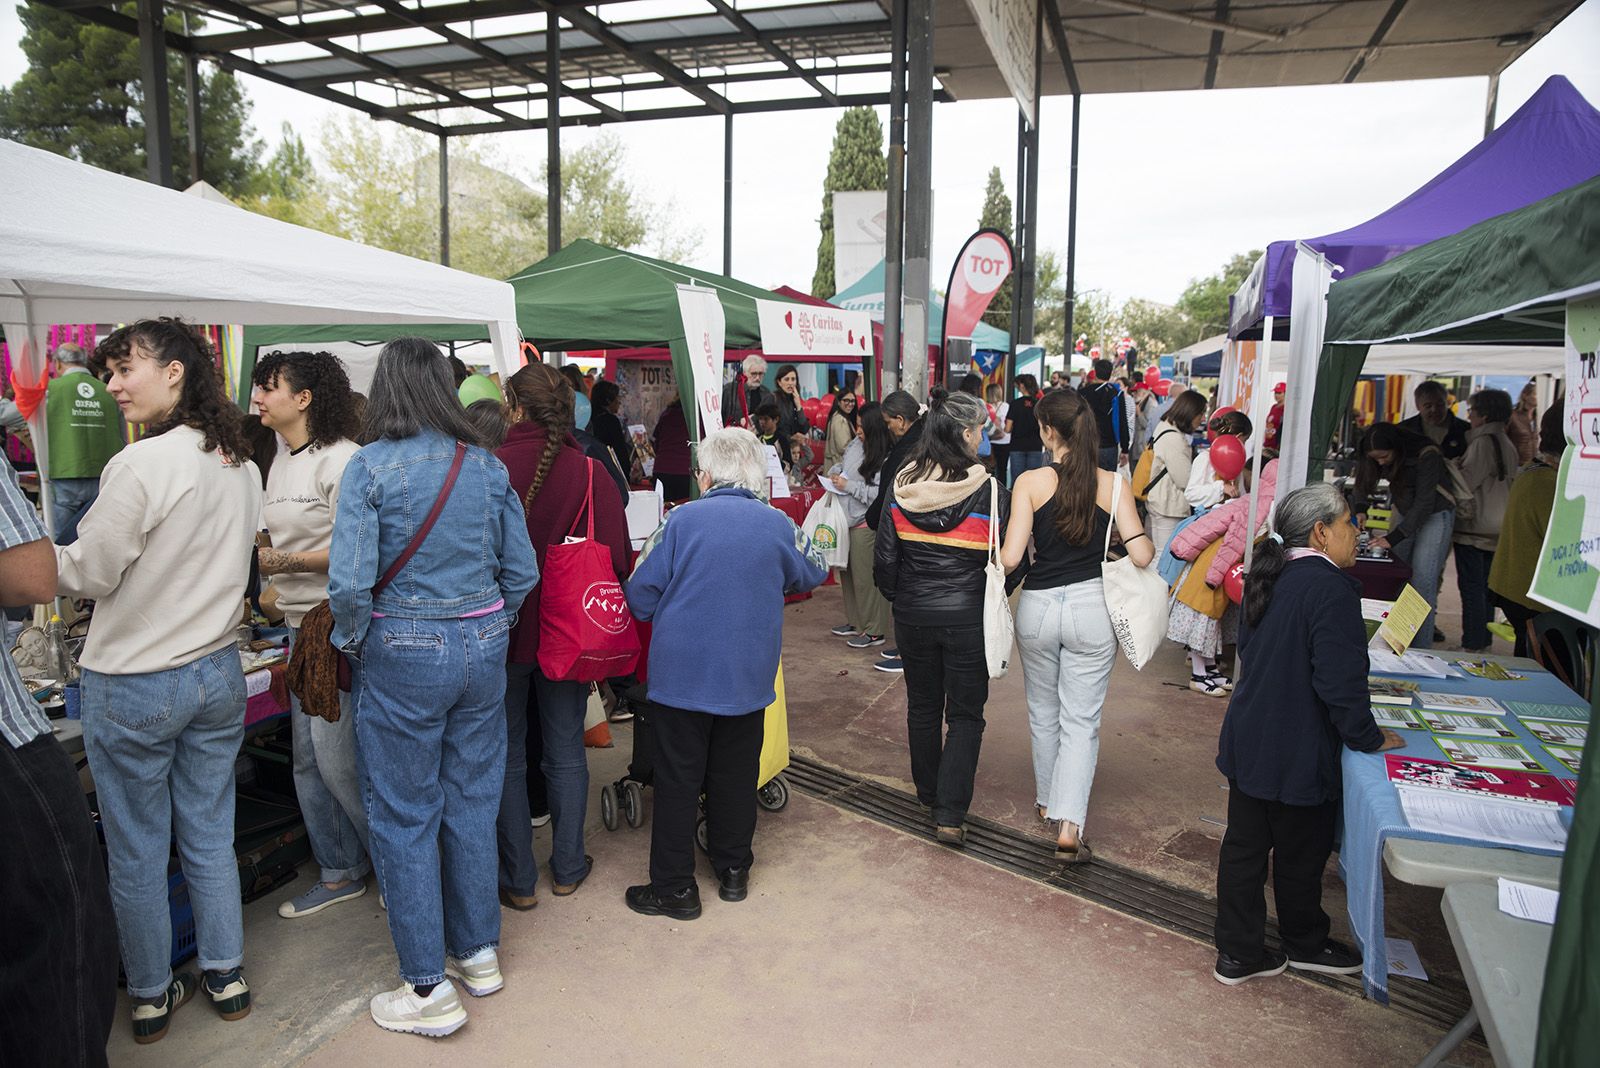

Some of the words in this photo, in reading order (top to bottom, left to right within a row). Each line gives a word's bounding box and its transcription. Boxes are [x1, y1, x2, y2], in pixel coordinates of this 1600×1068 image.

[970, 255, 1004, 277] TOT
[812, 313, 844, 333] Càritas
[75, 400, 100, 408] OXFAM
